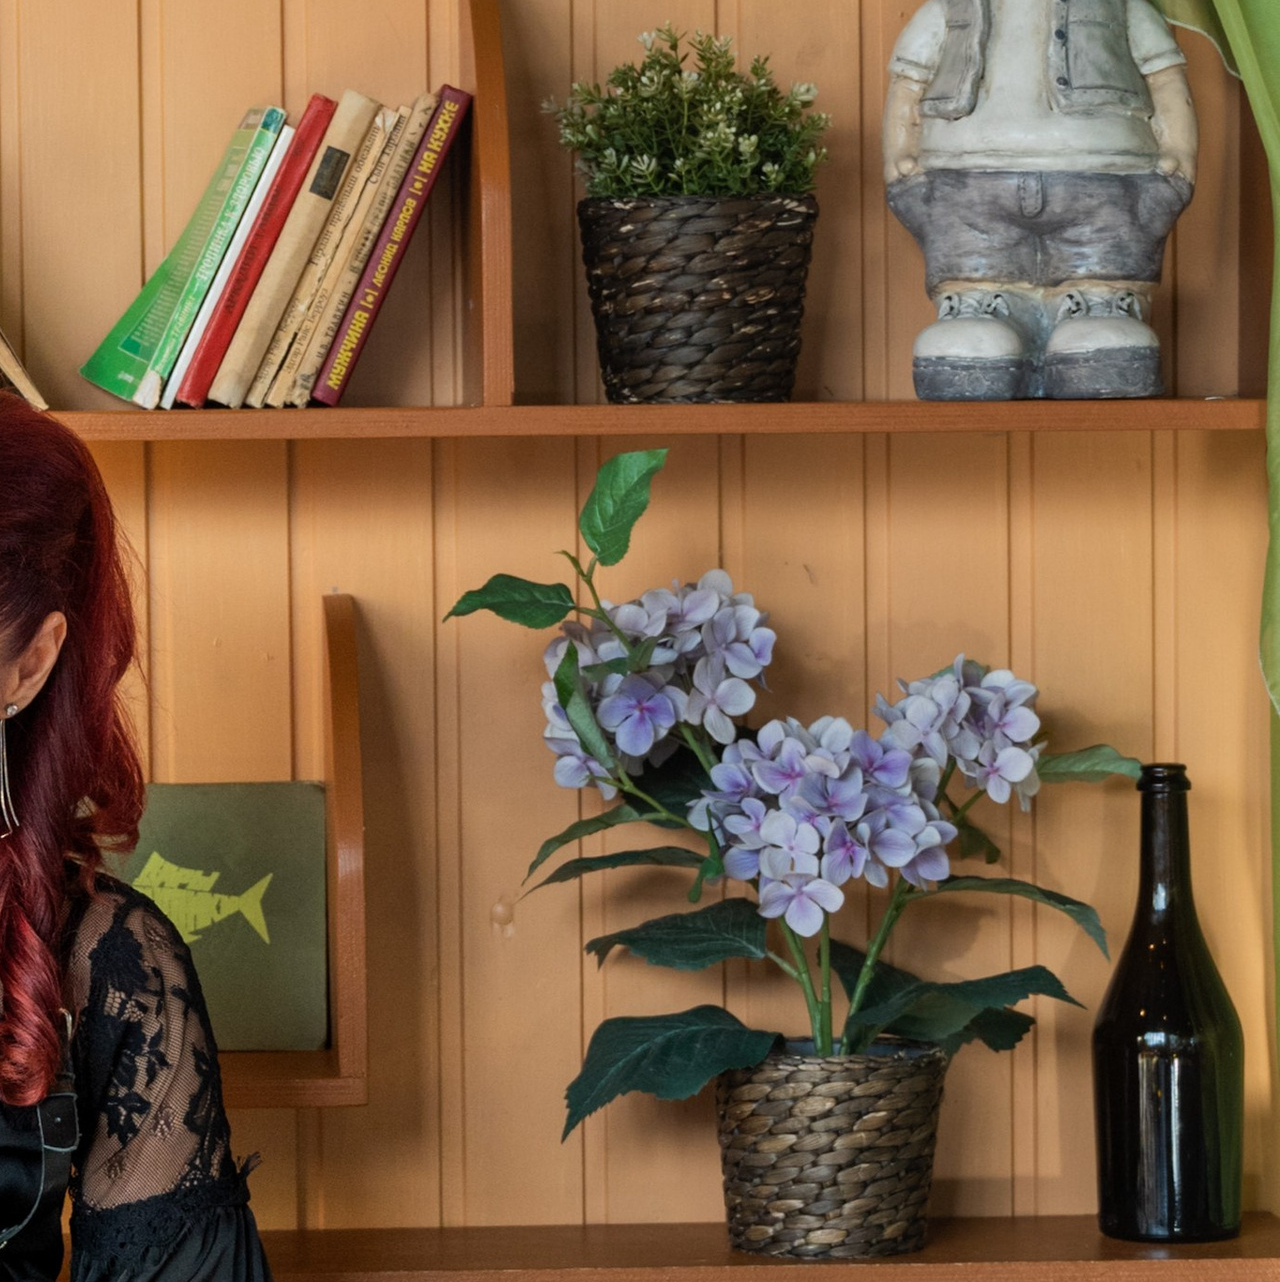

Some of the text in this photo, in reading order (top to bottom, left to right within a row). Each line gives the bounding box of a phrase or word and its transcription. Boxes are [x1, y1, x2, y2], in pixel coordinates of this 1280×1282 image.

[227, 143, 267, 210] ЗДОРОВЬЮ
[222, 207, 237, 220] К
[282, 112, 408, 375] Эдгар Райс Берроуз Сын Тарзана
[306, 226, 336, 268] Тарзан
[324, 99, 459, 390] МУЖЧИНА ЛЕОНИД КАРПОВ НА КУХНЕ
[194, 216, 234, 283] ТРОПИНКА
[323, 290, 352, 339] ТРАВКИН
